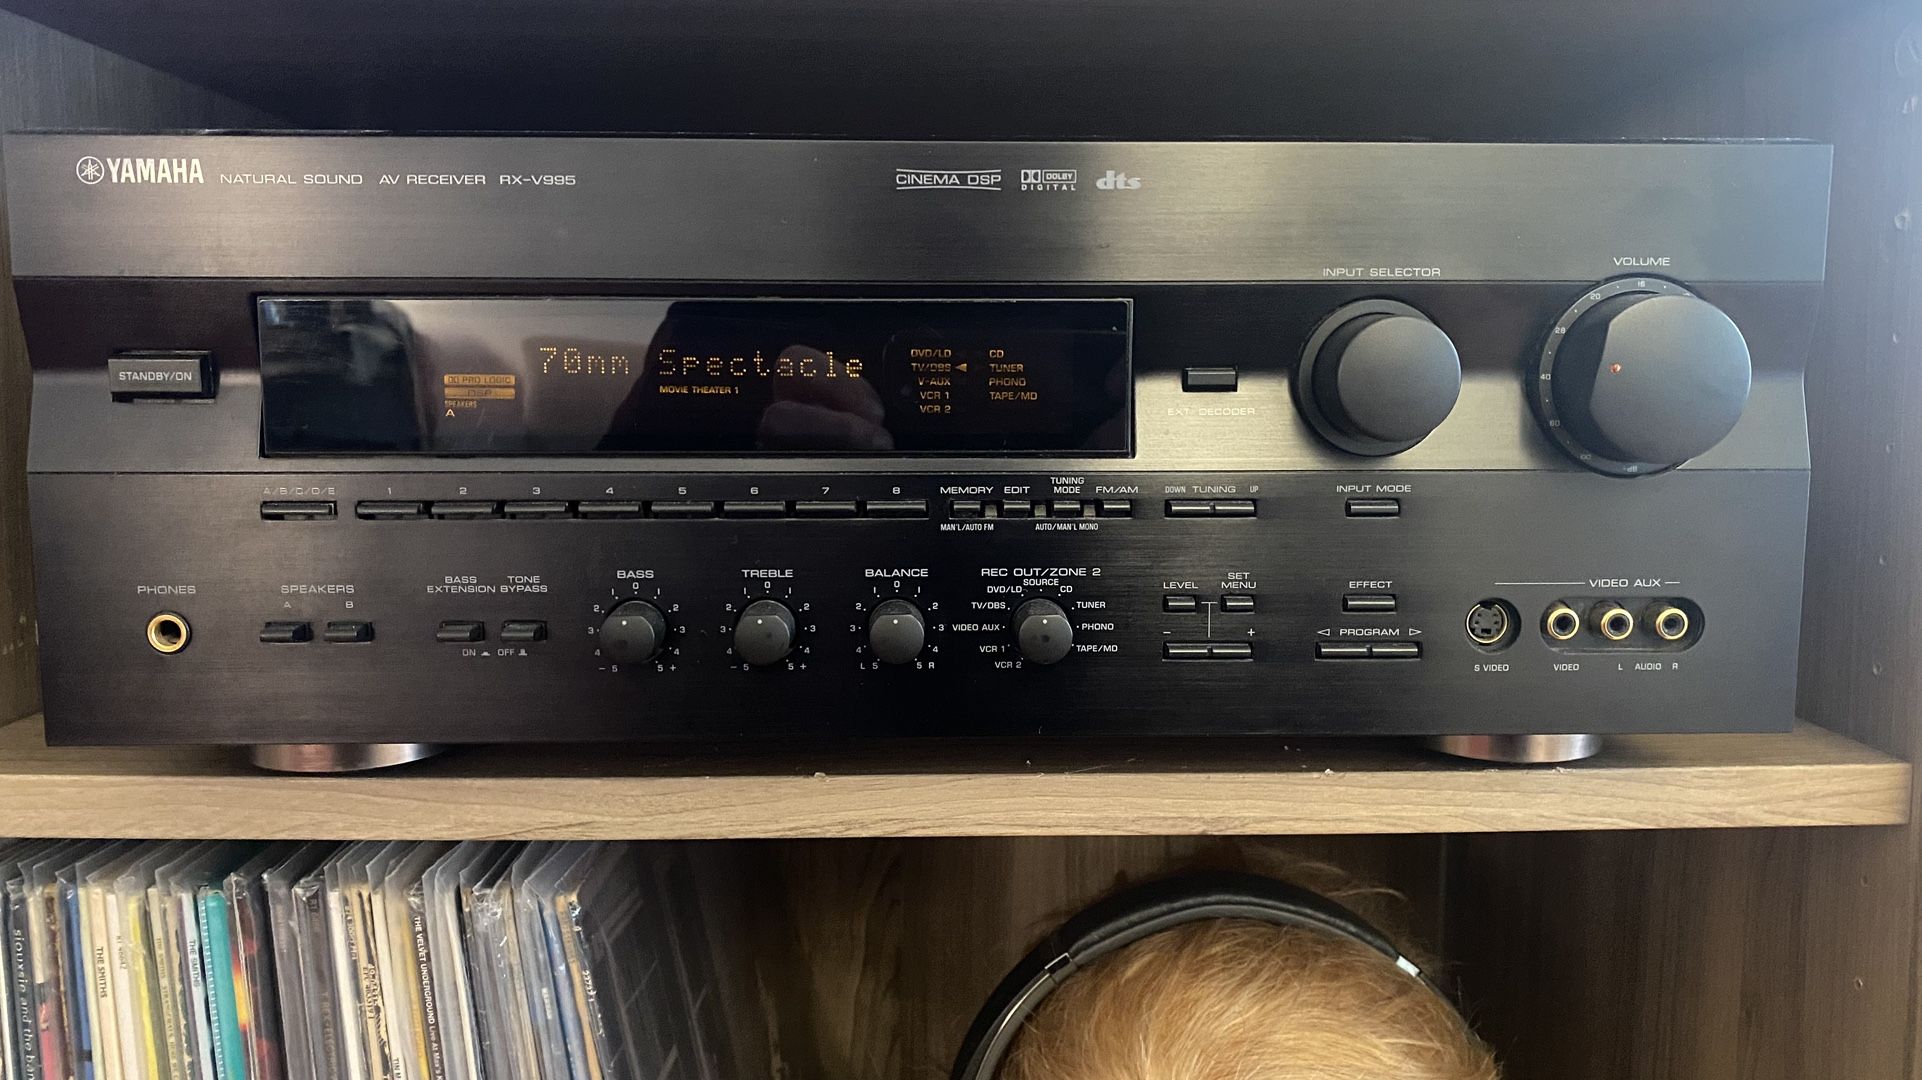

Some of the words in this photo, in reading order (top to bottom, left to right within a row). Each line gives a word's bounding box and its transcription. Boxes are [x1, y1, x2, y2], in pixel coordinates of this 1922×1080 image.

[106, 158, 204, 184] YAMAHA
[220, 173, 297, 185] NATURAL
[303, 173, 363, 185] SOUND
[379, 173, 400, 185] AV
[407, 173, 486, 185] RECEIVER
[500, 174, 576, 185] RX-V995
[896, 173, 960, 186] CINEMA
[967, 174, 1001, 186] DSP
[1046, 172, 1073, 180] DOLBY
[1096, 170, 1142, 190] dts
[1613, 256, 1671, 266] VOLUME
[1322, 267, 1364, 277] INPUT
[1369, 267, 1441, 277] SELECTOR
[911, 349, 951, 358] DVD/LD
[989, 349, 1004, 358] CD
[539, 347, 630, 375] 70mm
[658, 349, 864, 378] Spectacle
[911, 363, 951, 372] TV/DBS
[989, 363, 1024, 373] TUNER
[118, 371, 192, 381] STANDBY/ON
[463, 376, 480, 384] PRO
[484, 376, 511, 384] LOGIC
[1540, 373, 1551, 381] 40
[918, 377, 951, 387] V-AUX
[988, 377, 1026, 387] PHONO
[659, 385, 689, 394] MOVIE
[692, 385, 732, 395] THEATER
[734, 386, 739, 395] 1
[919, 391, 941, 400] VCR
[989, 391, 1038, 400] TAPE/MD
[445, 408, 455, 417] A
[919, 405, 941, 414] VCR
[944, 405, 951, 414] 2
[1198, 407, 1256, 416] DECODER
[1050, 477, 1085, 485] TUNING
[263, 486, 336, 496] A/B/C/D/E
[459, 487, 468, 495] 2
[532, 487, 541, 495] 3
[605, 487, 614, 495] 4
[678, 487, 687, 495] 5
[750, 487, 759, 495] 6
[822, 487, 831, 495] 7
[892, 487, 901, 495] 8
[940, 486, 994, 494] MEMORY
[1004, 486, 1030, 494] EDIT
[1053, 486, 1081, 494] MODE
[1095, 486, 1139, 494] FM/AM
[1165, 485, 1186, 493] DOWN
[1192, 485, 1236, 493] TUNING
[1250, 485, 1259, 493] UP
[1336, 485, 1372, 493] INPUT
[1376, 485, 1412, 493] MODE
[940, 523, 982, 531] MAN'L/AUTO
[984, 523, 994, 531] FM
[1035, 523, 1078, 531] AUTO/MAN'L
[1079, 523, 1099, 531] MONO
[617, 570, 654, 579] BASS
[741, 569, 794, 578] TREBLE
[864, 568, 929, 577] BALANCE
[981, 568, 1008, 577] REC
[1013, 568, 1087, 577] OUT/ZONE
[1092, 568, 1101, 576] 2
[1227, 572, 1250, 580] SET
[444, 576, 477, 584] BASS
[507, 576, 541, 584] TONE
[893, 580, 900, 588] 0
[1589, 579, 1629, 588] VIDEO
[1633, 579, 1661, 588] AUX
[280, 584, 355, 594] SPEAKERS
[427, 585, 496, 593] EXTENSION
[500, 585, 548, 593] BYPASS
[632, 582, 639, 590] 0
[764, 581, 771, 589] 0
[1060, 585, 1073, 593] CD
[1163, 581, 1199, 589] LEVEL
[1221, 581, 1257, 589] MENU
[1349, 581, 1393, 589] EFFECT
[137, 585, 197, 594] PHONES
[283, 601, 292, 609] A
[345, 601, 354, 609] B
[672, 604, 679, 612] 2
[803, 603, 810, 611] 2
[932, 602, 939, 610] 2
[971, 602, 1006, 610] TV/DBS
[1076, 601, 1106, 609] TUNER
[1339, 628, 1400, 636] PROGRAM
[462, 649, 476, 657] ON
[497, 648, 515, 656] OFF
[673, 648, 680, 656] 4
[979, 645, 998, 653] VCR
[657, 664, 664, 672] 5
[994, 661, 1013, 669] VCR
[1483, 664, 1509, 672] VIDEO
[1553, 663, 1579, 671] VIDEO
[1635, 663, 1662, 671] AUDIO
[414, 916, 422, 931] THE
[189, 939, 197, 955] THE
[416, 933, 427, 962] VELVET
[96, 946, 105, 965] THE
[14, 929, 27, 993] siouxsie
[190, 957, 201, 988] SMITHS
[98, 966, 108, 999] SMITHS
[420, 964, 435, 1025] UNDERGROUND
[20, 997, 32, 1024] and
[23, 1028, 34, 1051] the
[431, 1042, 439, 1051] At
